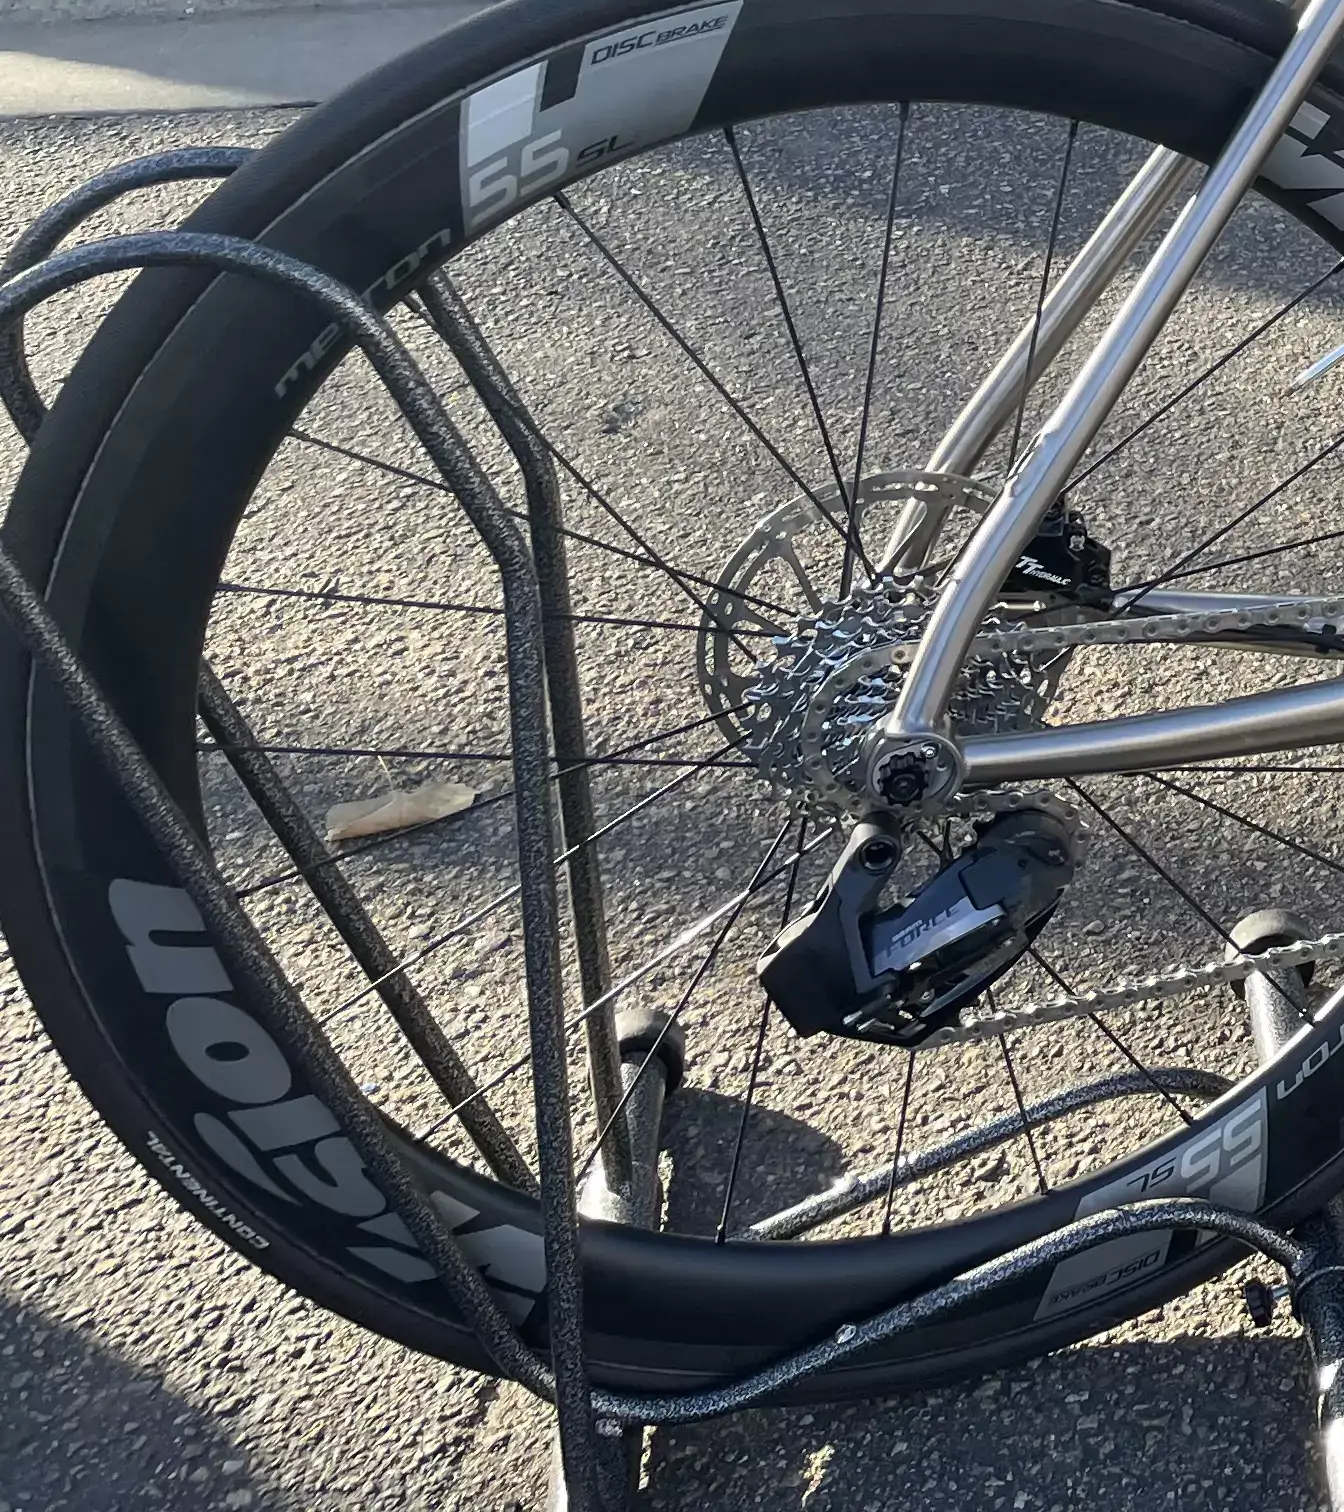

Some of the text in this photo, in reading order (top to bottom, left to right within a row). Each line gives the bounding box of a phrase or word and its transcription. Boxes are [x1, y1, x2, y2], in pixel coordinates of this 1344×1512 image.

[590, 14, 729, 66] DISC BRAKE
[470, 129, 570, 218] 55
[146, 1129, 270, 1251] CONTINENTAL
